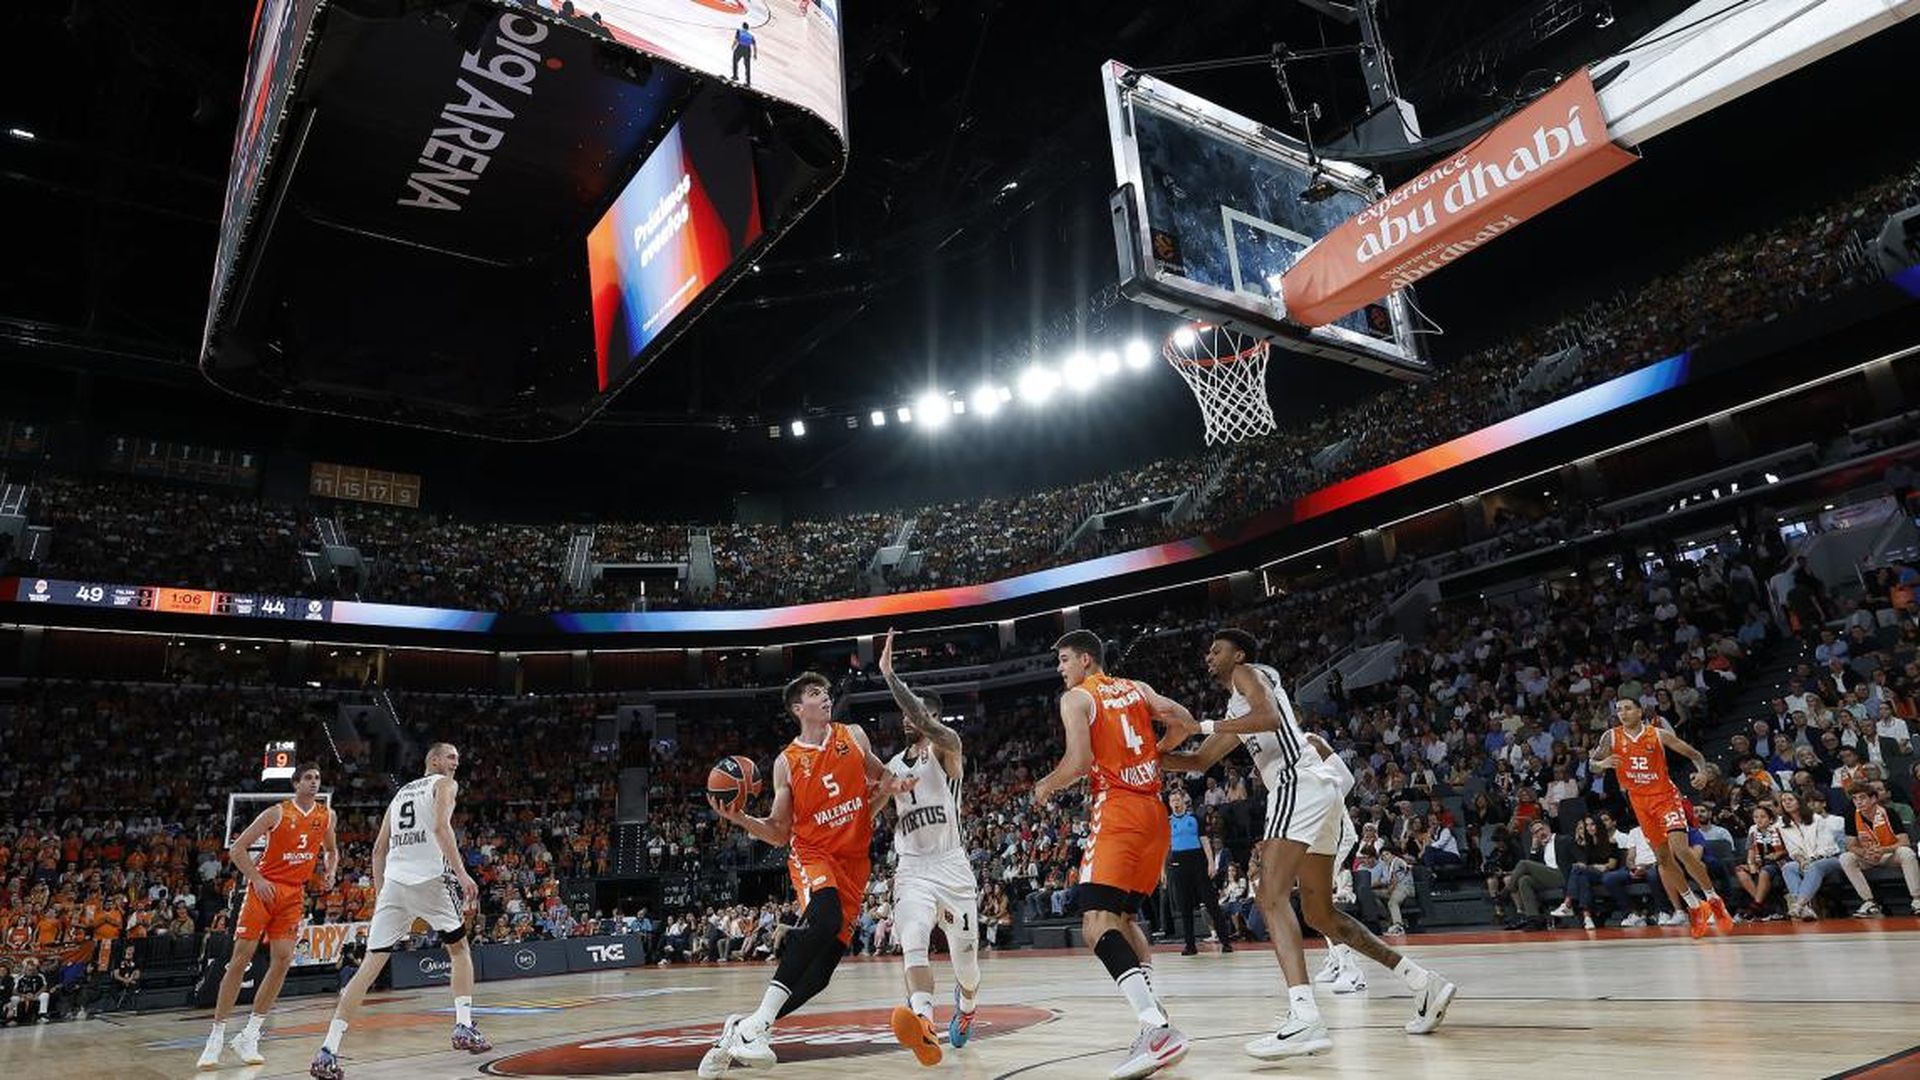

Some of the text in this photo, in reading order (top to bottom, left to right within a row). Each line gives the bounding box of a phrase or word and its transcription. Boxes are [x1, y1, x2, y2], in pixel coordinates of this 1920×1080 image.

[396, 78, 516, 211] ARENA
[1356, 105, 1588, 263] abu dhabí
[1356, 153, 1469, 226] experience
[1389, 255, 1440, 290] abu
[315, 477, 411, 502] 11 15 17 9
[75, 586, 104, 602] 49
[171, 593, 203, 605] 1:06
[261, 599, 286, 615] 44
[1120, 713, 1145, 755] 4
[276, 753, 288, 769] 9
[1629, 756, 1649, 770] 32
[821, 772, 840, 798] 5
[399, 800, 415, 830] 9
[813, 796, 863, 826] VALENCIA
[297, 833, 308, 849] 3
[963, 912, 970, 932] 1
[586, 943, 626, 962] TKE
